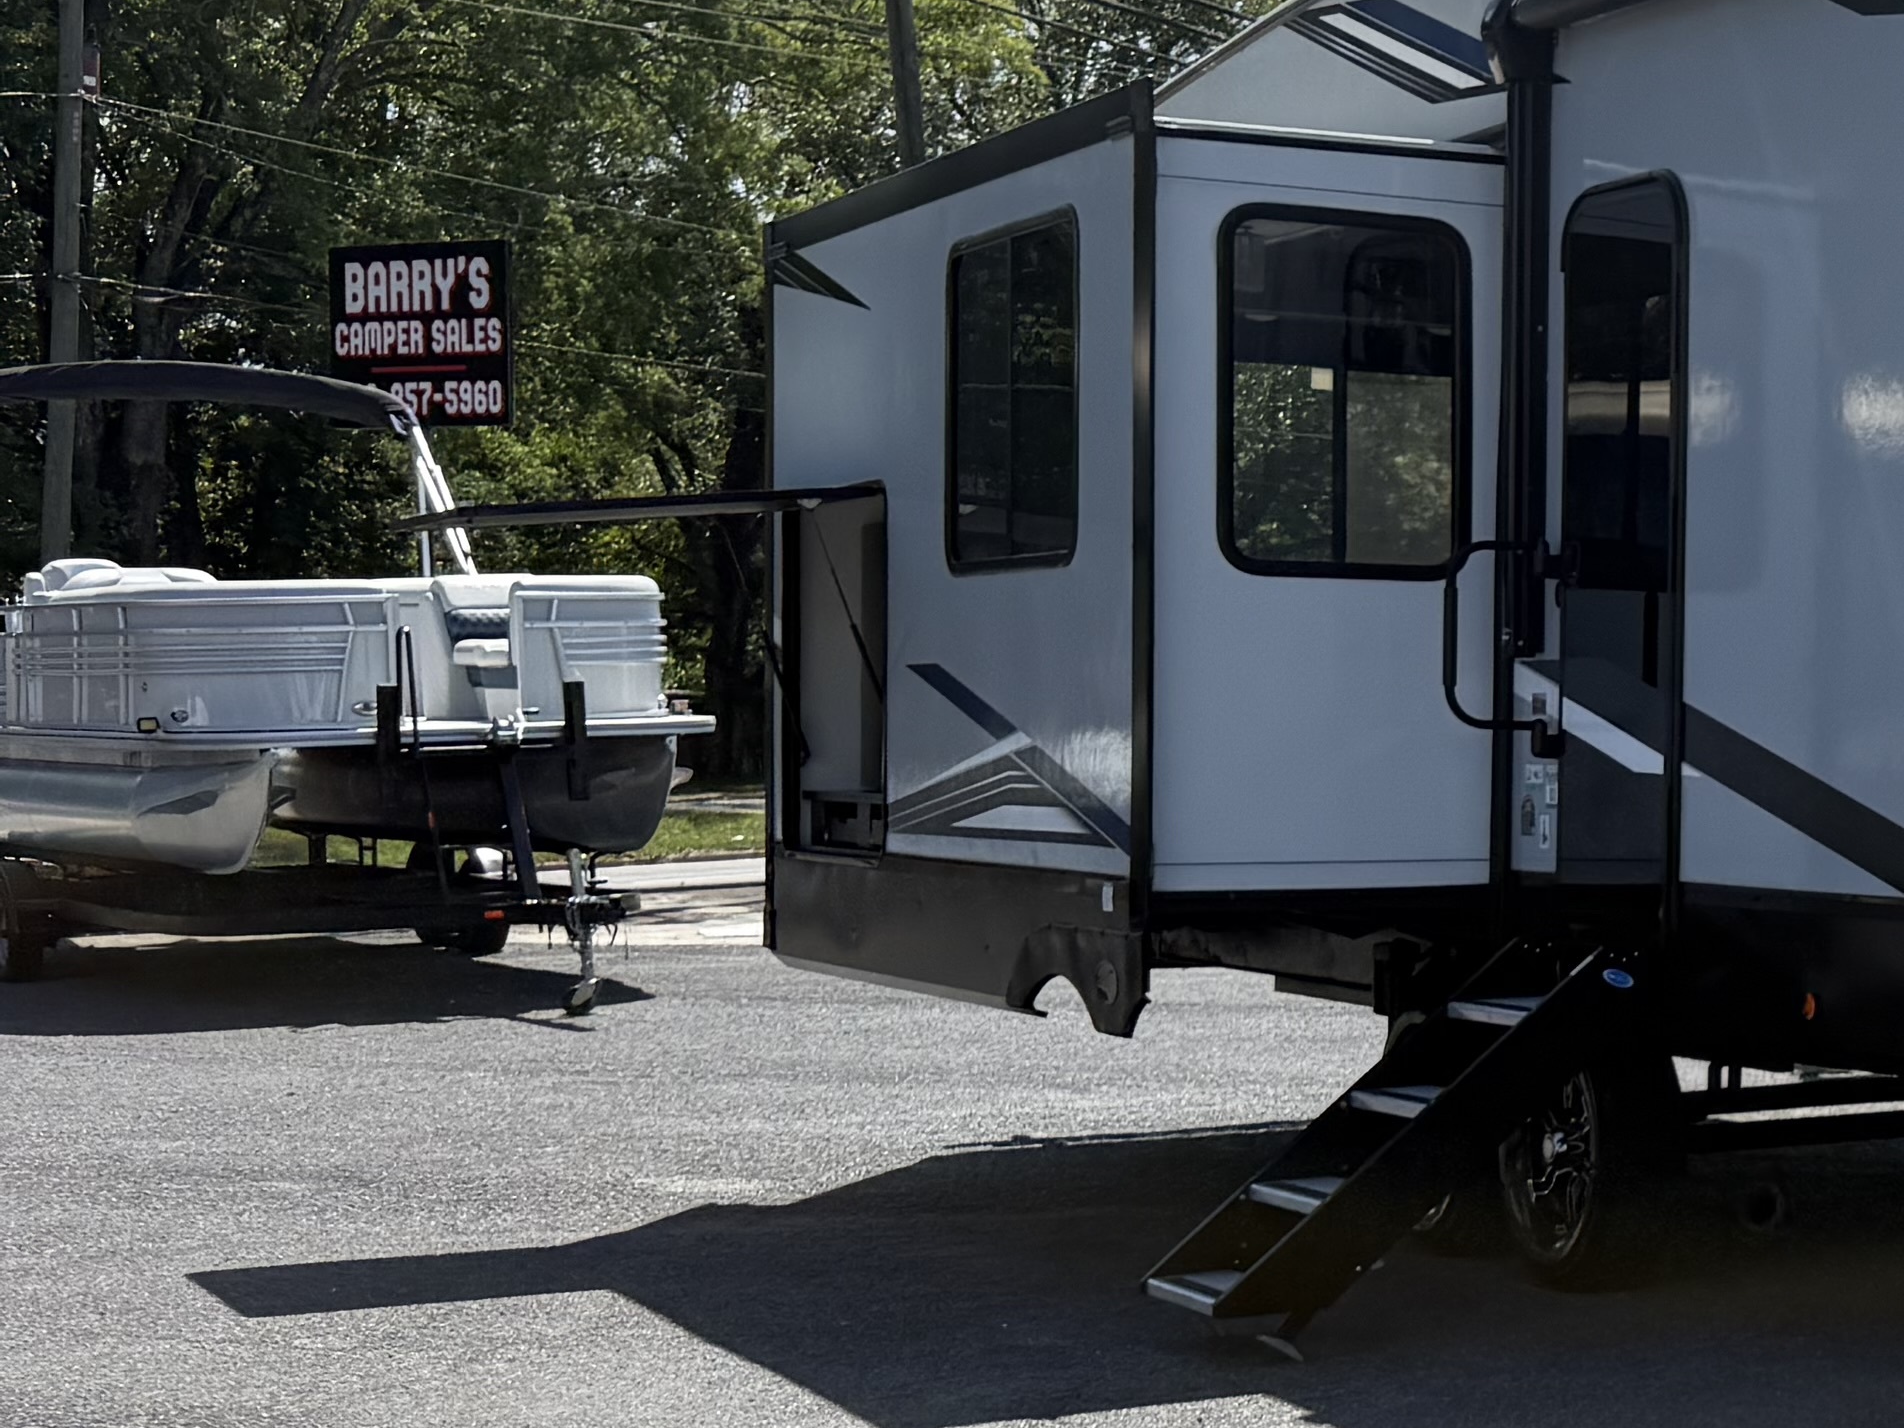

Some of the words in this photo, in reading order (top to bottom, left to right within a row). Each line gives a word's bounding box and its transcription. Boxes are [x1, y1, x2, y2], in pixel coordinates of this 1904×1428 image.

[344, 256, 492, 315] BARRY'S
[334, 320, 425, 357] CAMPER
[430, 317, 502, 355] SALES
